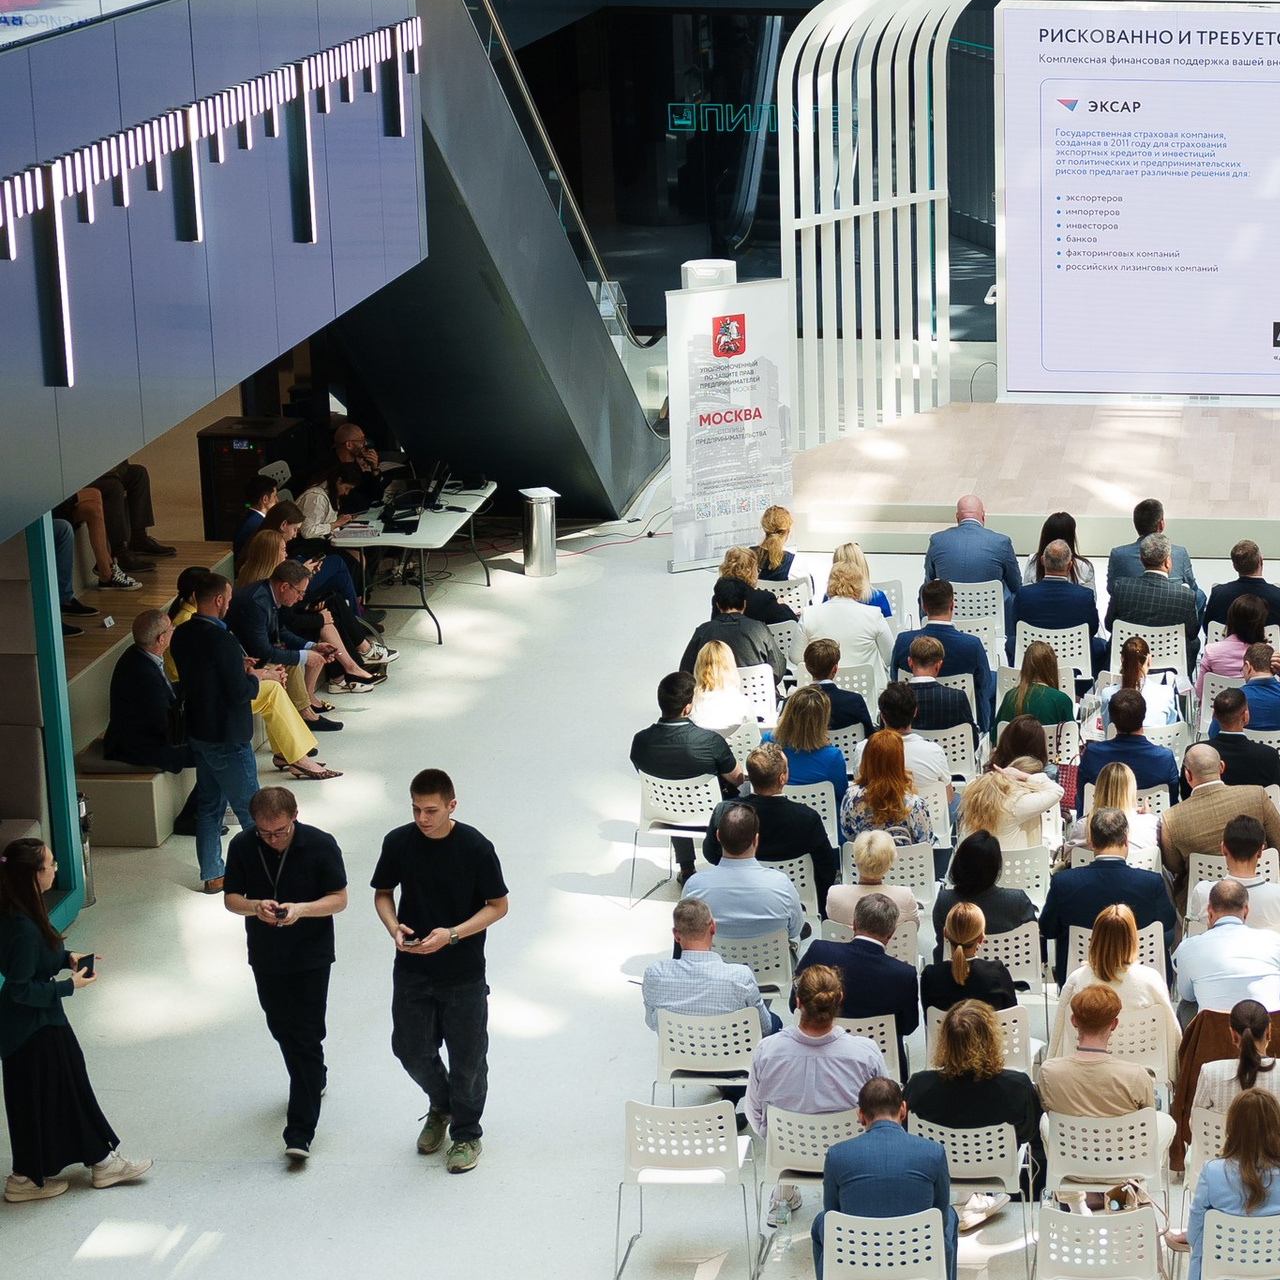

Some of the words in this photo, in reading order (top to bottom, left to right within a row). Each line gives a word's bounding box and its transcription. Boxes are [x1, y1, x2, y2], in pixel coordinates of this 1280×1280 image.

[1038, 28, 1173, 44] РИСКОВАННО
[1178, 30, 1191, 44] И
[1038, 54, 1107, 64] Комплексная
[1109, 55, 1170, 67] финансовая
[1172, 58, 1230, 67] поддержка
[1232, 56, 1264, 66] вашей
[1088, 100, 1141, 113] ЭКСАР
[1055, 128, 1132, 139] Государственная
[1133, 131, 1179, 140] страховая
[1180, 132, 1226, 140] компания,
[1054, 140, 1101, 148] созданная
[1110, 139, 1129, 147] 2011
[1130, 141, 1151, 149] году
[1152, 141, 1169, 149] для
[1170, 142, 1227, 150] страхования
[1055, 150, 1108, 158] экспортных
[1110, 150, 1152, 158] кредитов
[1161, 149, 1216, 159] инвестиций
[1140, 160, 1241, 168] предпринимательских
[1055, 169, 1087, 177] рисков
[1088, 169, 1138, 177] предлагает
[1140, 170, 1189, 178] различные
[1190, 170, 1230, 178] решения
[1065, 195, 1123, 203] экспортеров
[1065, 209, 1120, 217] импортеров
[1065, 223, 1118, 231] инвесторов
[1065, 234, 1098, 242] банков
[1065, 248, 1134, 258] факторинговых
[1136, 249, 1180, 257] компаний
[1065, 262, 1118, 272] российских
[1174, 263, 1218, 271] компаний
[698, 406, 763, 427] МОСКВА
